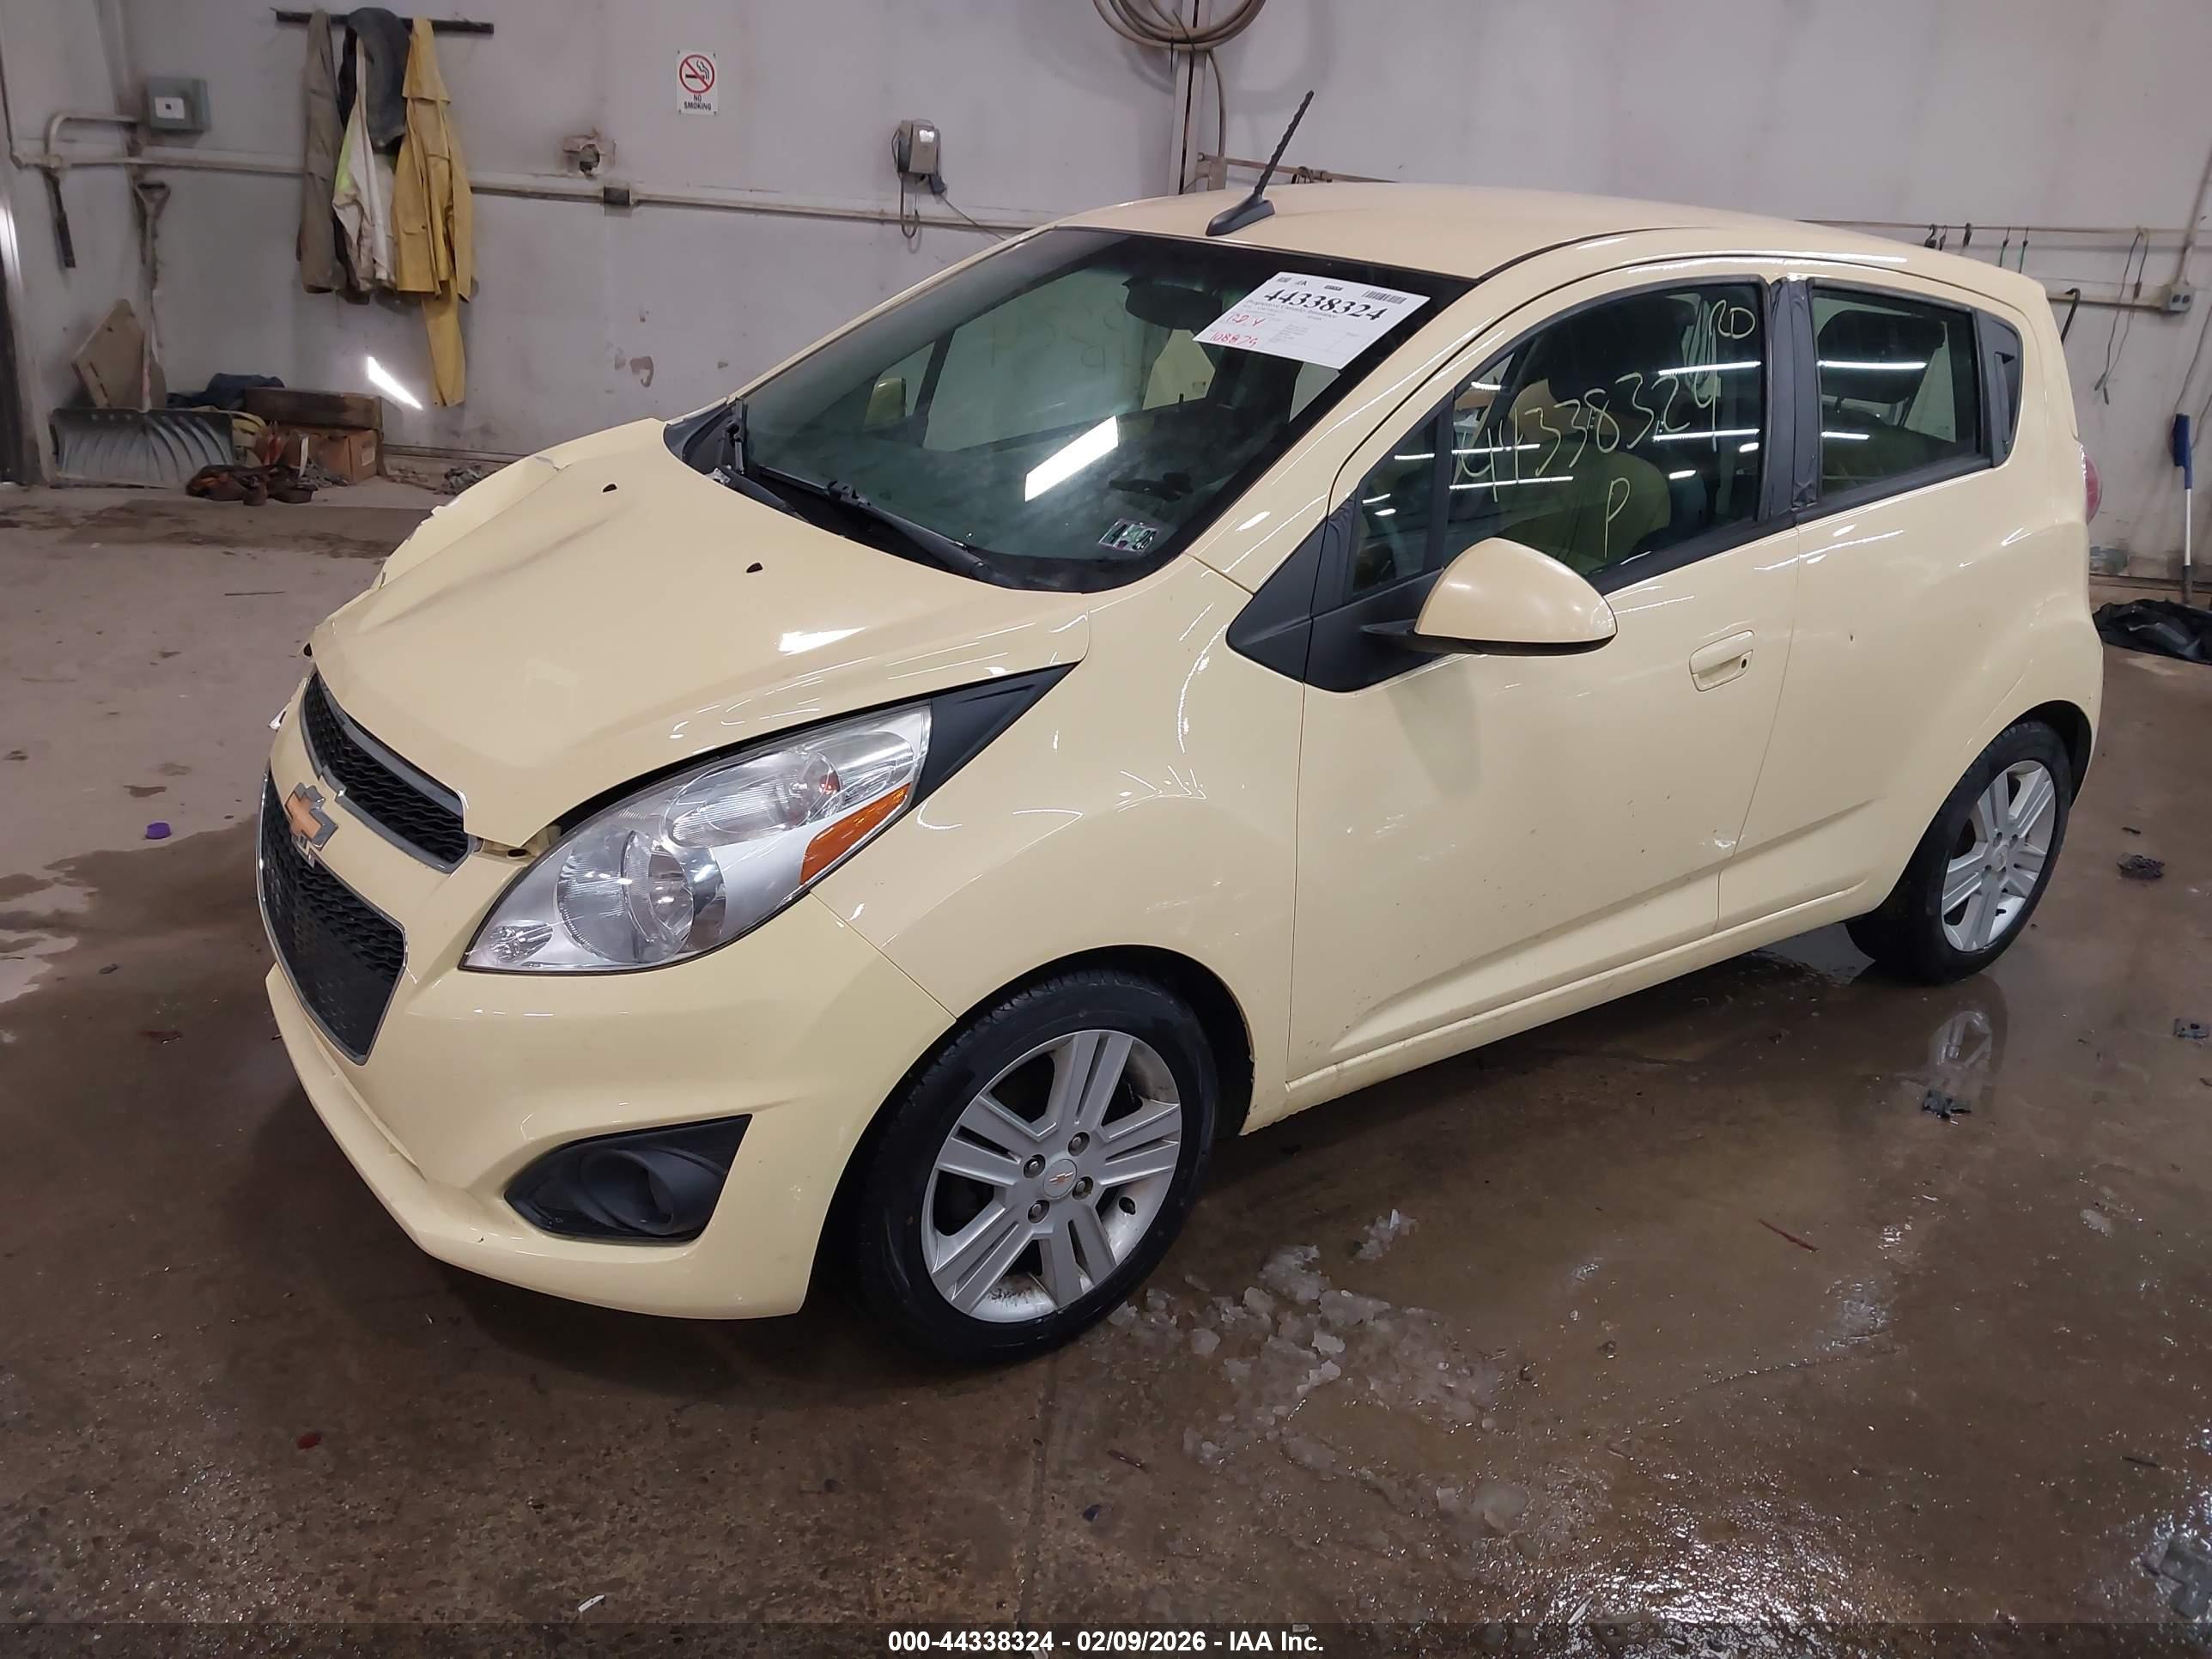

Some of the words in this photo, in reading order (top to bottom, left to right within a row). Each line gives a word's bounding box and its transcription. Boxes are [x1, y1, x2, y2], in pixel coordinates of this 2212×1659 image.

[684, 101, 712, 111] SMOKING
[1264, 289, 1389, 321] 44338324
[1460, 331, 1718, 503] 44338324
[1603, 477, 1632, 559] P
